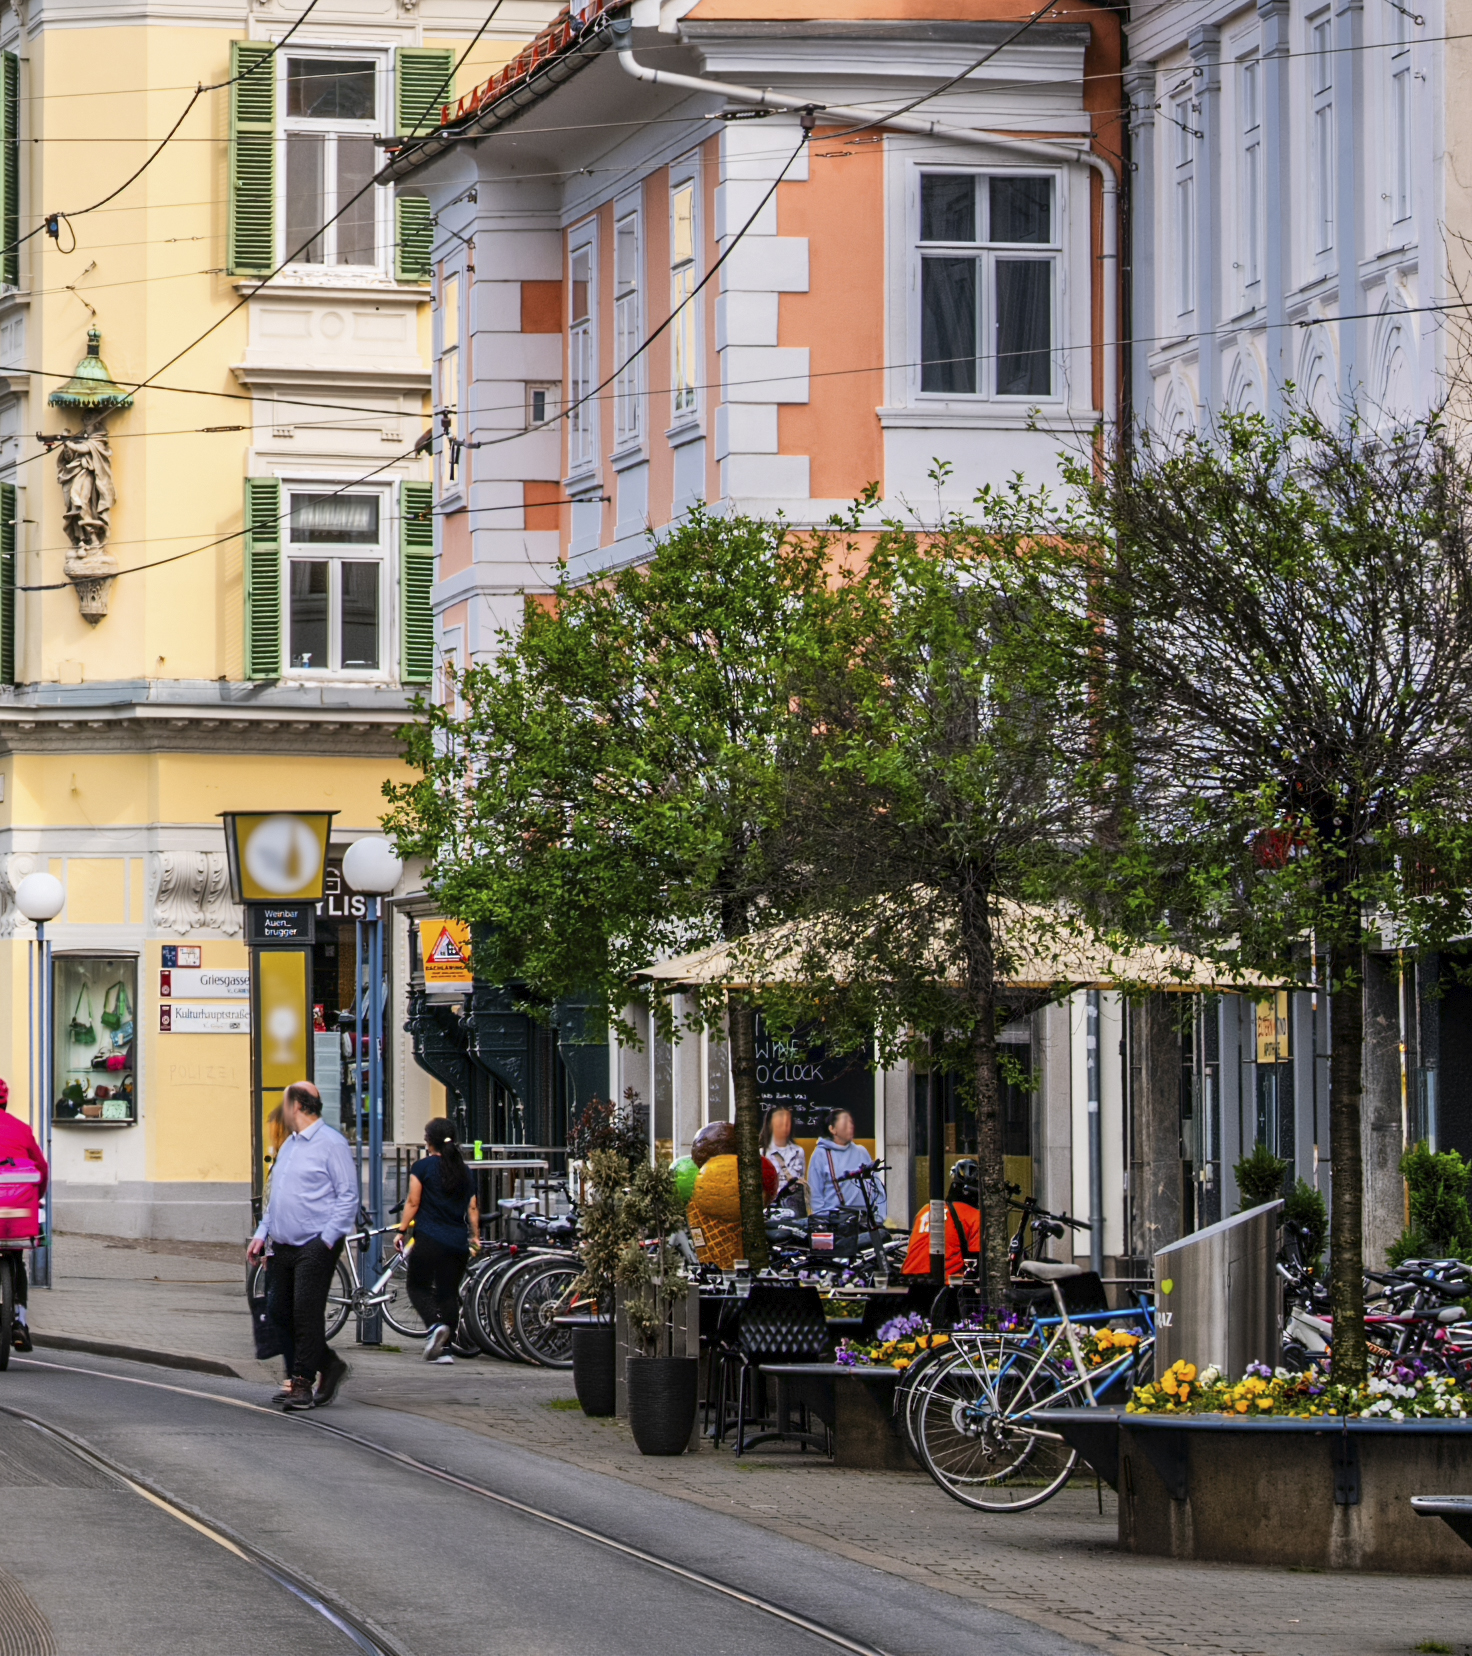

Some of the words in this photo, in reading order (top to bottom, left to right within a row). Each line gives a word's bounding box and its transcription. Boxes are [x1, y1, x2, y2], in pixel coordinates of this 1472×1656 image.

[264, 928, 298, 938] brugger
[200, 975, 250, 987] Griesgasse
[176, 1008, 250, 1022] Kulturhauptstraße
[170, 1065, 235, 1080] POLIZEI
[756, 1063, 824, 1084] O'CLOCK
